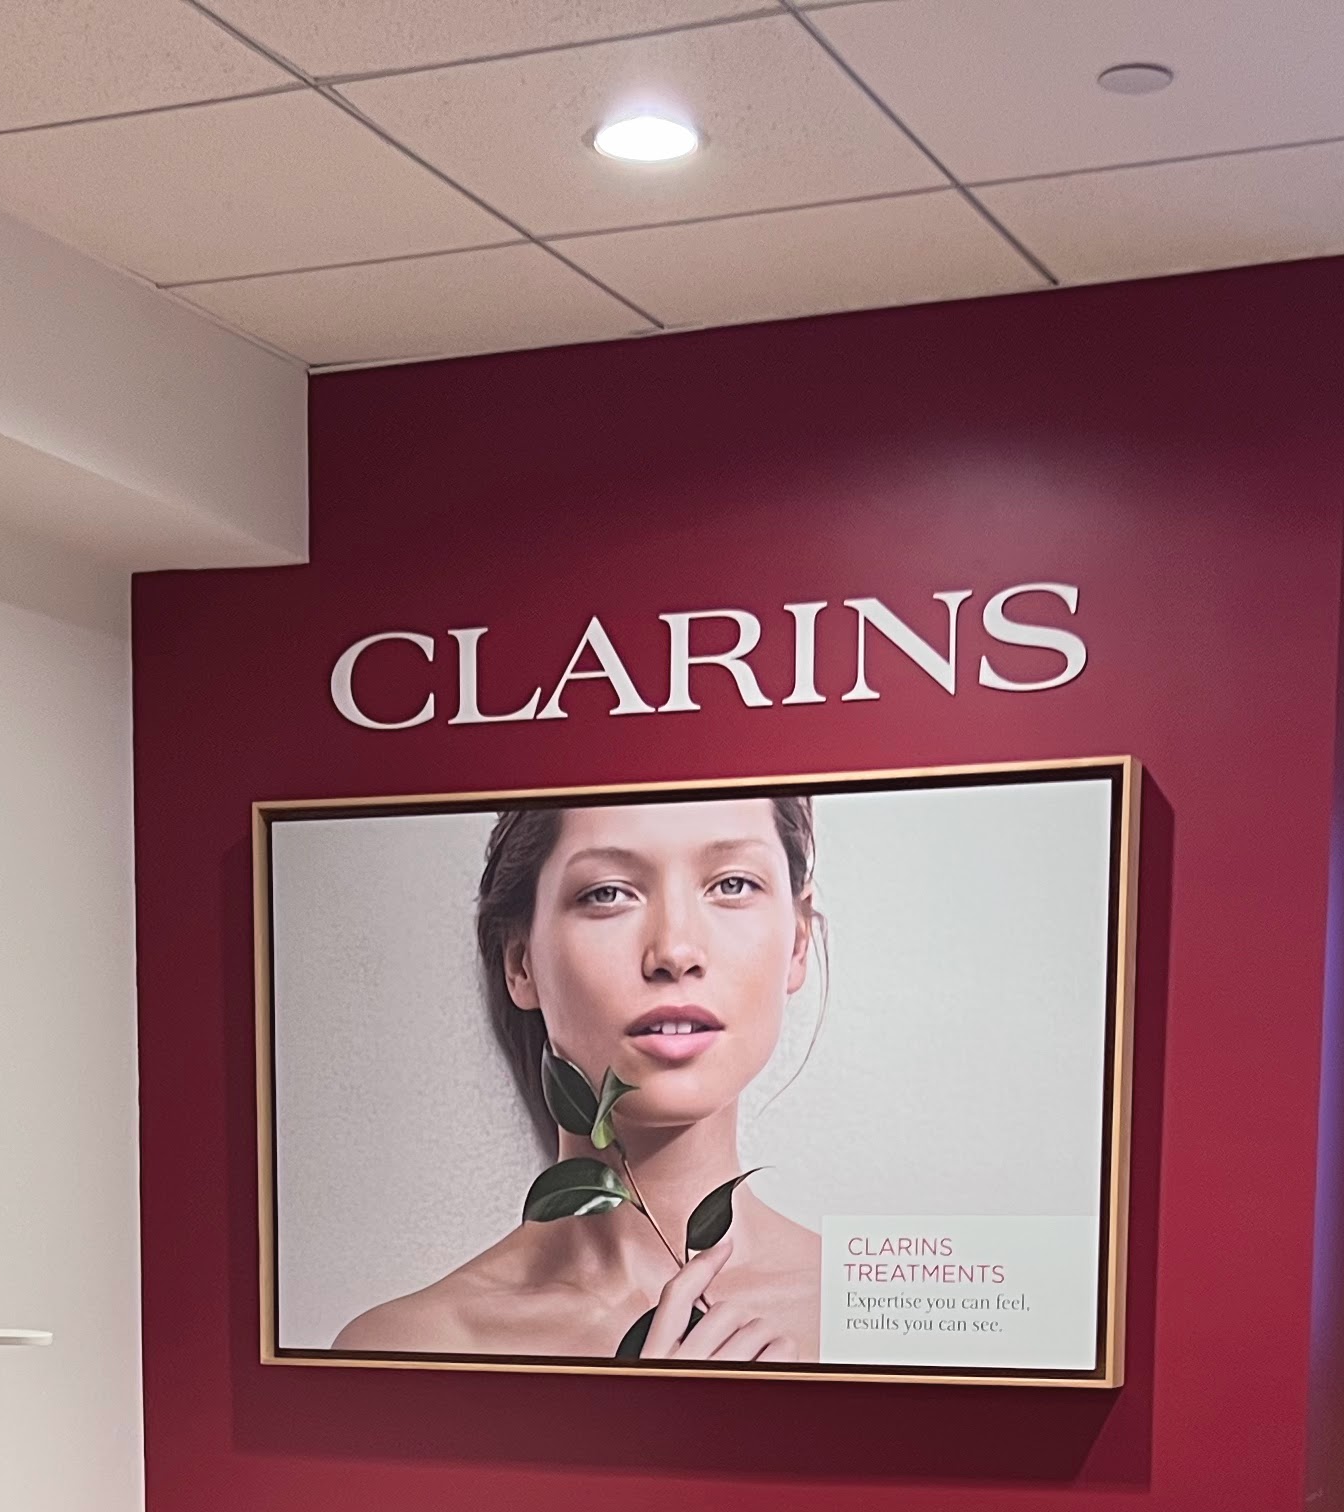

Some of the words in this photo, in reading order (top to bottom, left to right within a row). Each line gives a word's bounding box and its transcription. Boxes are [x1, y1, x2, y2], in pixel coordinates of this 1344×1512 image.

[329, 582, 1087, 730] CLARINS
[847, 1237, 953, 1256] CLARINS
[843, 1263, 1005, 1284] TREATMENTS
[846, 1292, 922, 1312] Expertise
[926, 1298, 956, 1314] you
[961, 1299, 990, 1310] can
[846, 1313, 899, 1330] results
[903, 1319, 933, 1336] you
[938, 1320, 967, 1331] can
[972, 1321, 1003, 1332] see.
